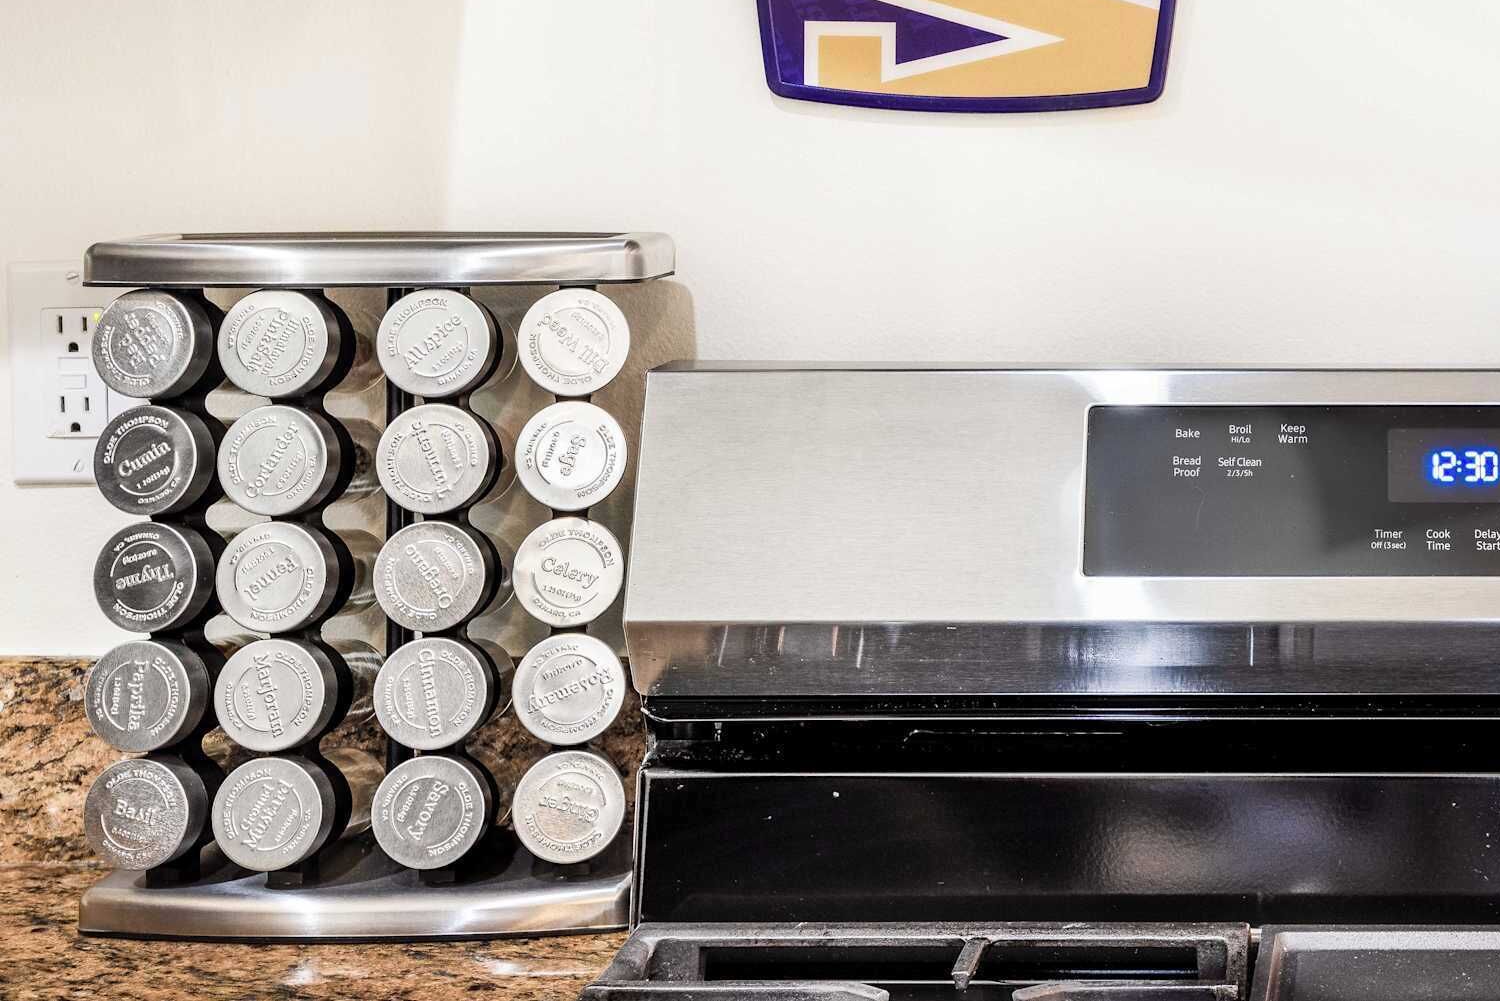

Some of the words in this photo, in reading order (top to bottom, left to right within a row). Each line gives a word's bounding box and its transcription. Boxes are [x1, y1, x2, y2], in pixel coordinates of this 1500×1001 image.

[102, 435, 118, 465] OLDE
[116, 415, 169, 434] THOMPSON
[1175, 428, 1200, 438] Bake
[1229, 424, 1252, 434] Broil
[1278, 435, 1308, 444] Warm
[1280, 424, 1306, 434] Keep
[116, 438, 171, 479] Cumin
[243, 421, 300, 499] Coriander
[557, 433, 587, 479] Sage
[1172, 456, 1201, 466] Bread
[1218, 457, 1236, 467] Self
[1236, 457, 1262, 467] Clean
[1432, 451, 1499, 482] 12:30
[575, 453, 616, 500] THOMPSON
[1173, 467, 1201, 477] Proof
[1227, 469, 1253, 477] 2/3/5h
[1370, 541, 1383, 549] Off
[1374, 529, 1403, 539] Timer
[1426, 529, 1451, 539] Cook
[1426, 541, 1451, 550] Time
[1476, 541, 1500, 550] Start
[114, 563, 174, 591] Thyme
[243, 556, 296, 602] Fennel
[403, 543, 454, 609] Oregano
[540, 554, 599, 588] Celery
[165, 581, 184, 607] OLDE
[111, 602, 166, 620] THOMPSON
[253, 654, 286, 738] Marjoram
[417, 648, 442, 736] Cinnamon
[524, 666, 614, 714] Rosemary
[238, 782, 275, 832] Ground
[408, 780, 448, 841] Savory
[458, 782, 473, 811] OLDE
[538, 796, 599, 824] Ginger
[242, 779, 292, 849] Mustard
[427, 812, 472, 857] THOMPSON
